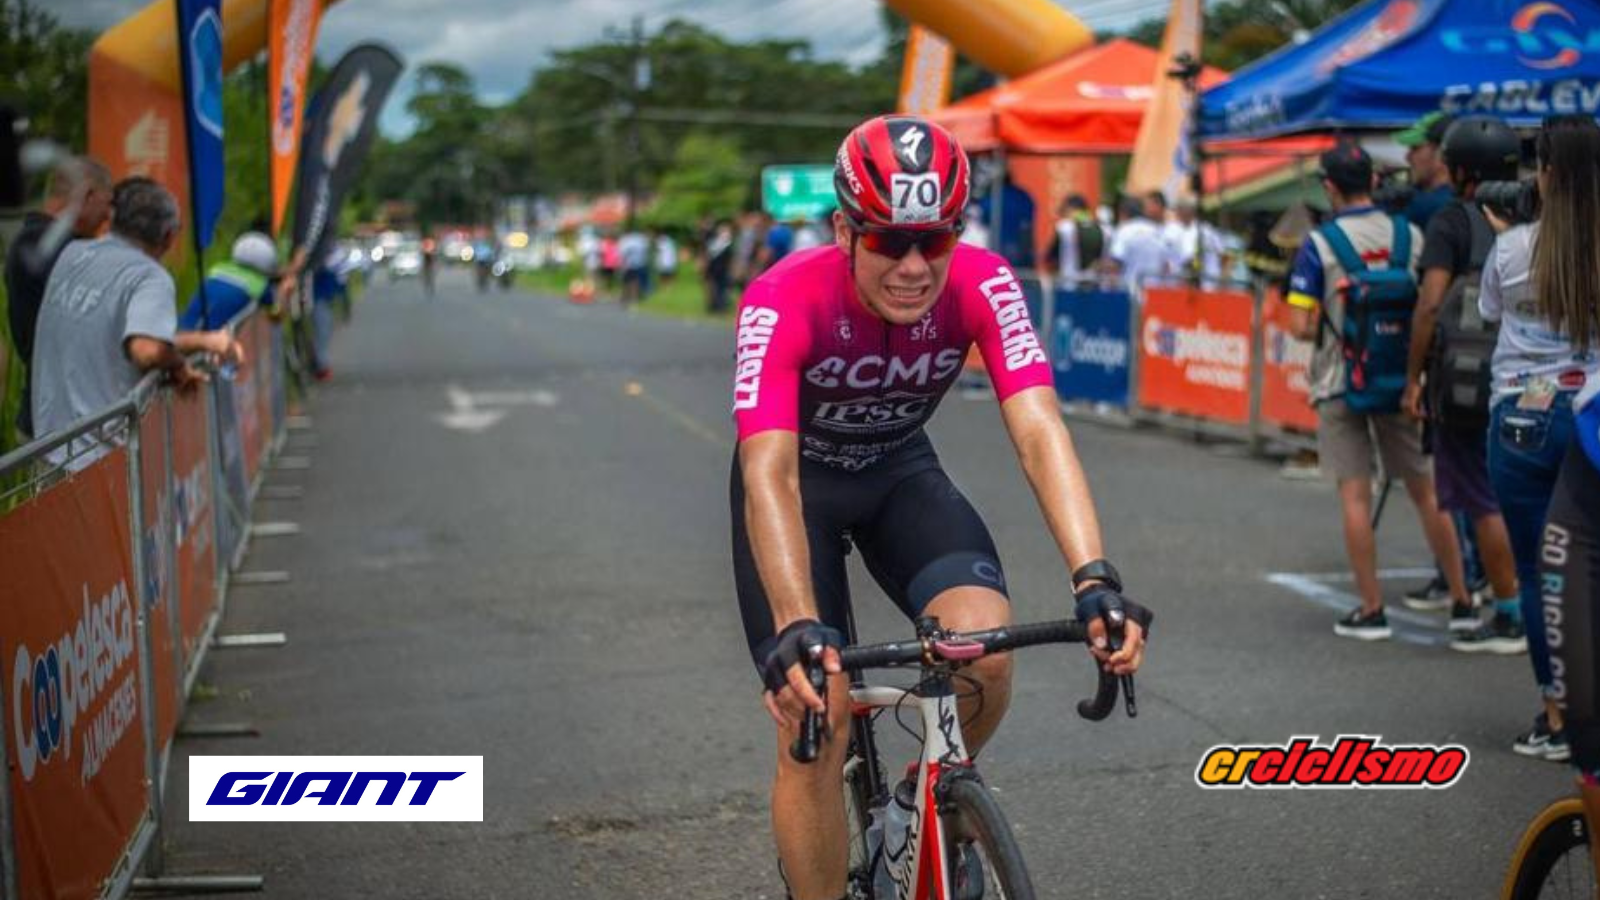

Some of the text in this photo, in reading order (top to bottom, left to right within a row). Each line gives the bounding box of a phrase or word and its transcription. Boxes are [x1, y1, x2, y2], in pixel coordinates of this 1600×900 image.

[894, 179, 938, 208] 70
[979, 265, 1048, 372] 226ERS
[1541, 522, 1570, 567] GO
[13, 577, 134, 782] Coopelesca
